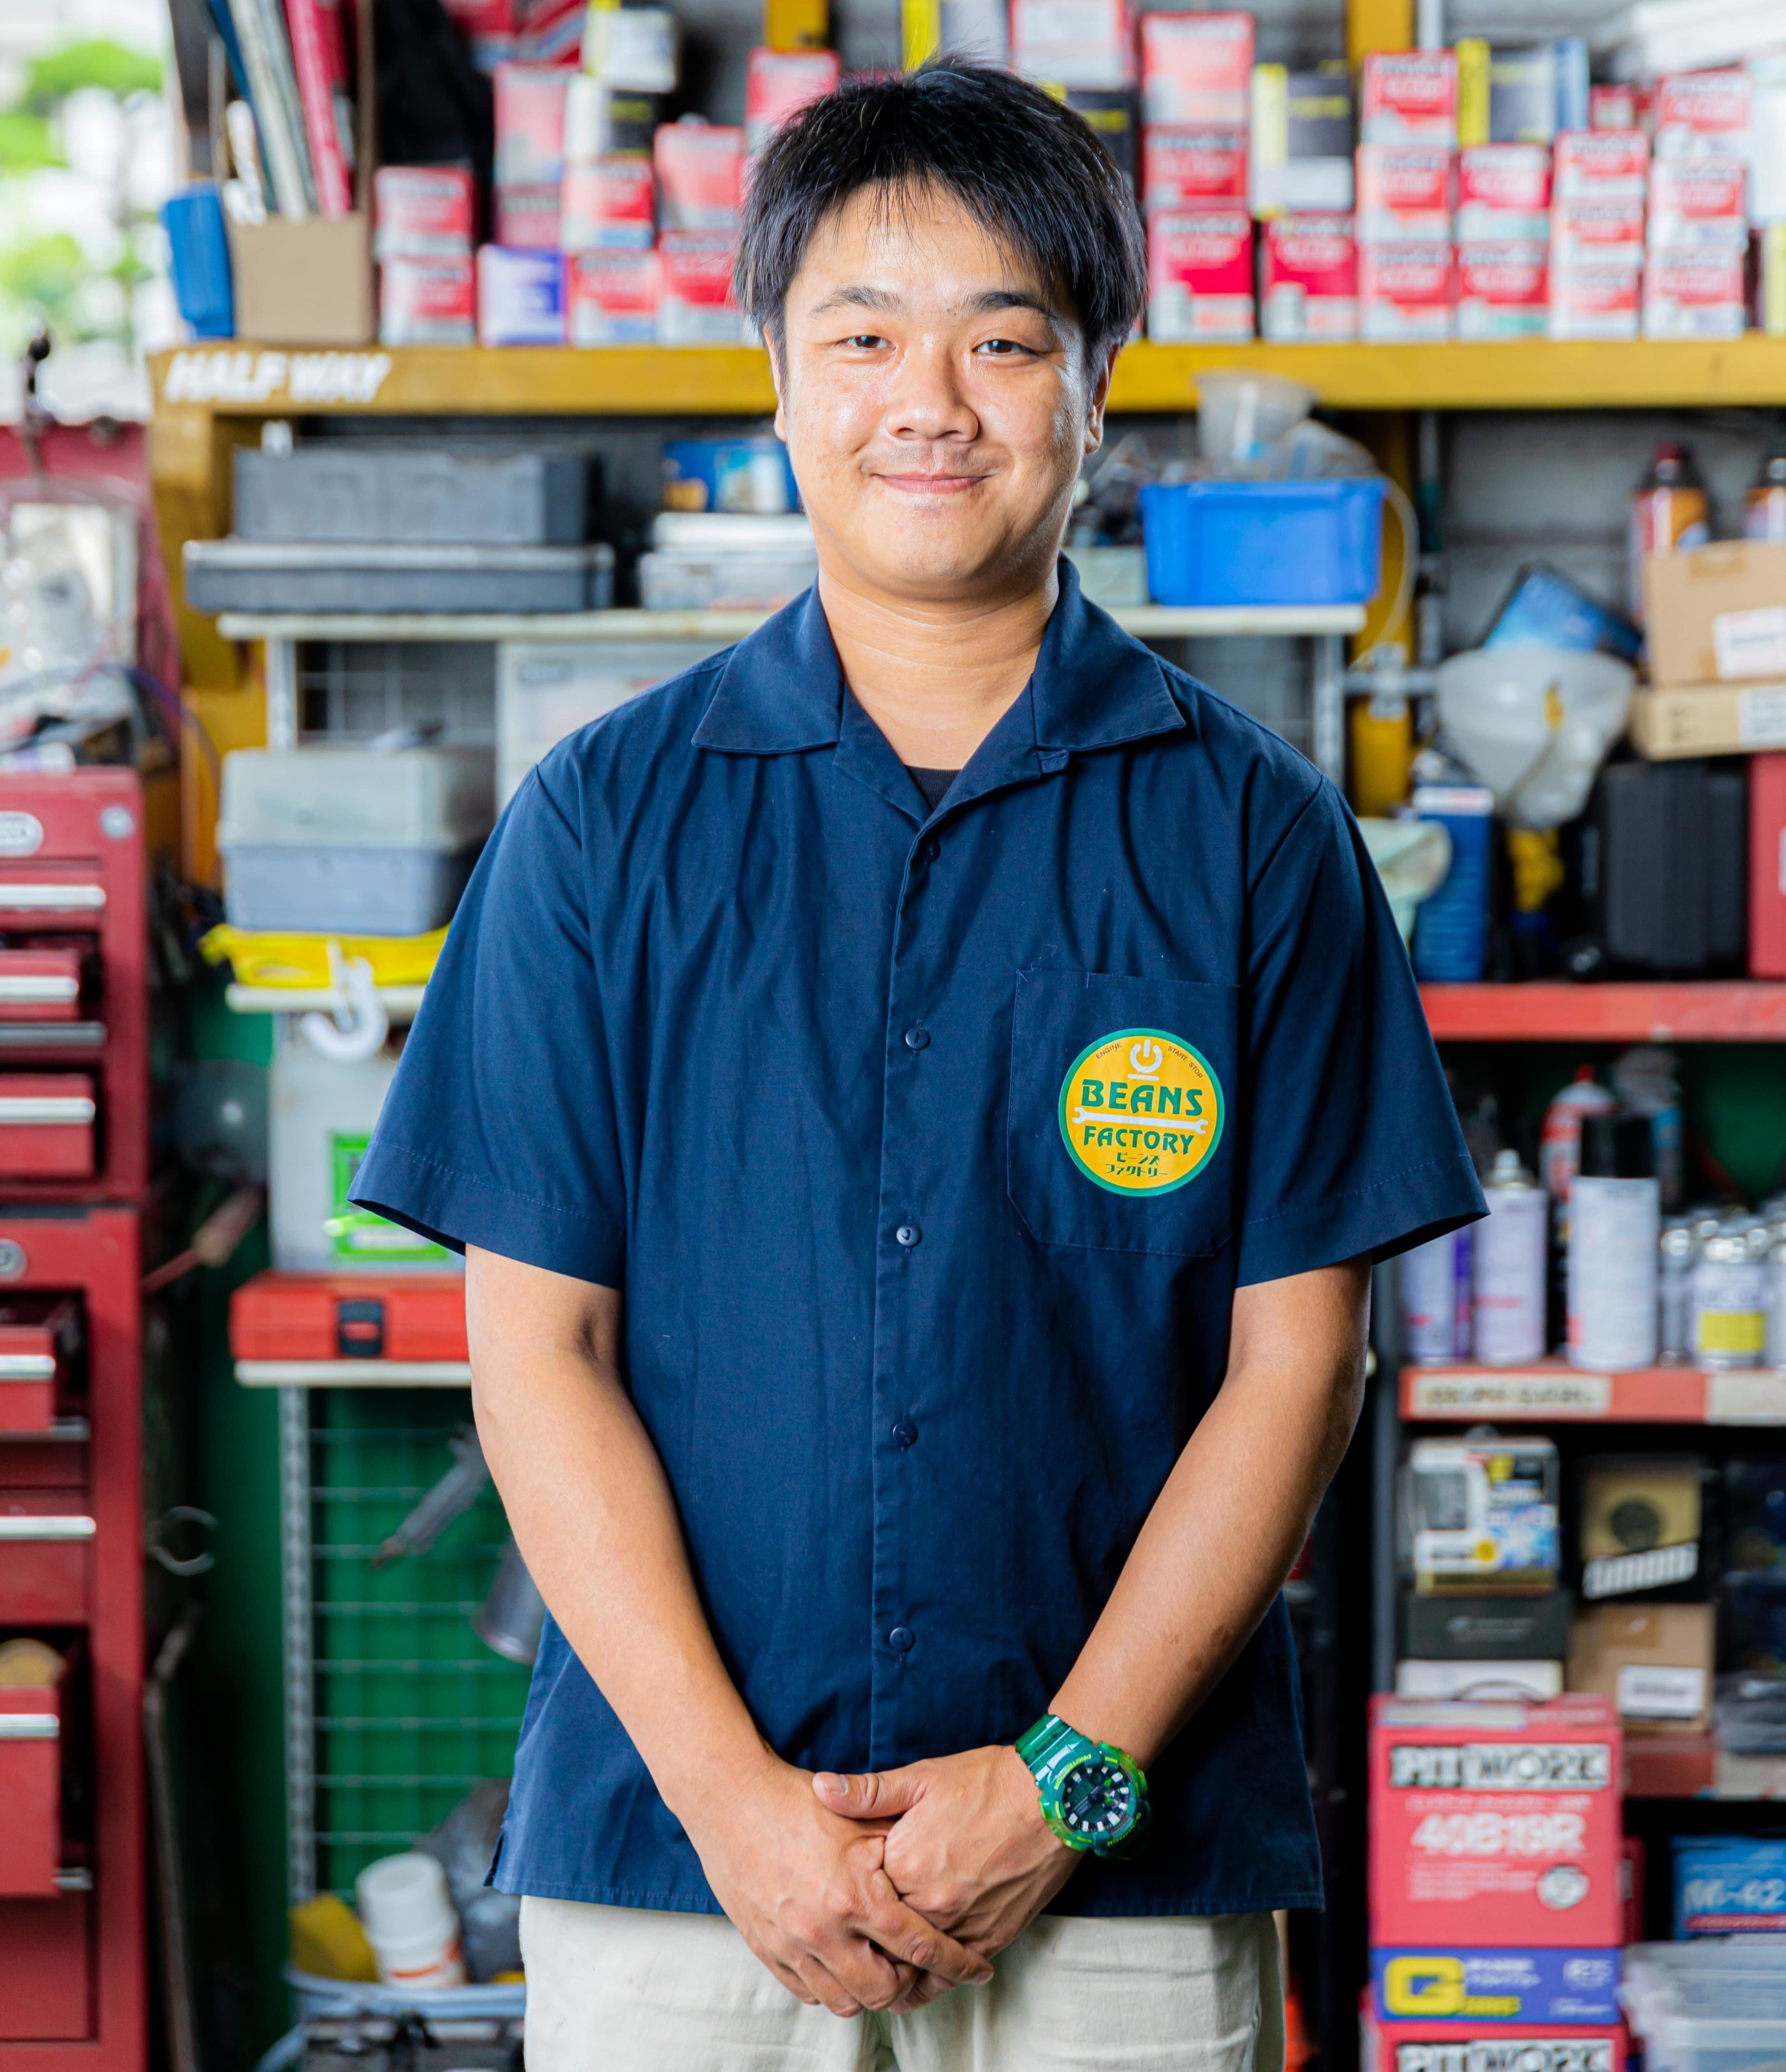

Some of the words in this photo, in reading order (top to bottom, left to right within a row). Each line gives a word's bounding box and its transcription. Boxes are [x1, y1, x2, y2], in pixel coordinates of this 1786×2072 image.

[1095, 1042, 1122, 1060] ENGINE
[1081, 1079, 1204, 1117] BEANS
[1083, 1125, 1194, 1156] FACTORY
[1104, 1163, 1168, 1177] ファクトリー
[1392, 1744, 1610, 1789] PITWORK
[1410, 1812, 1586, 1856] 40B19R
